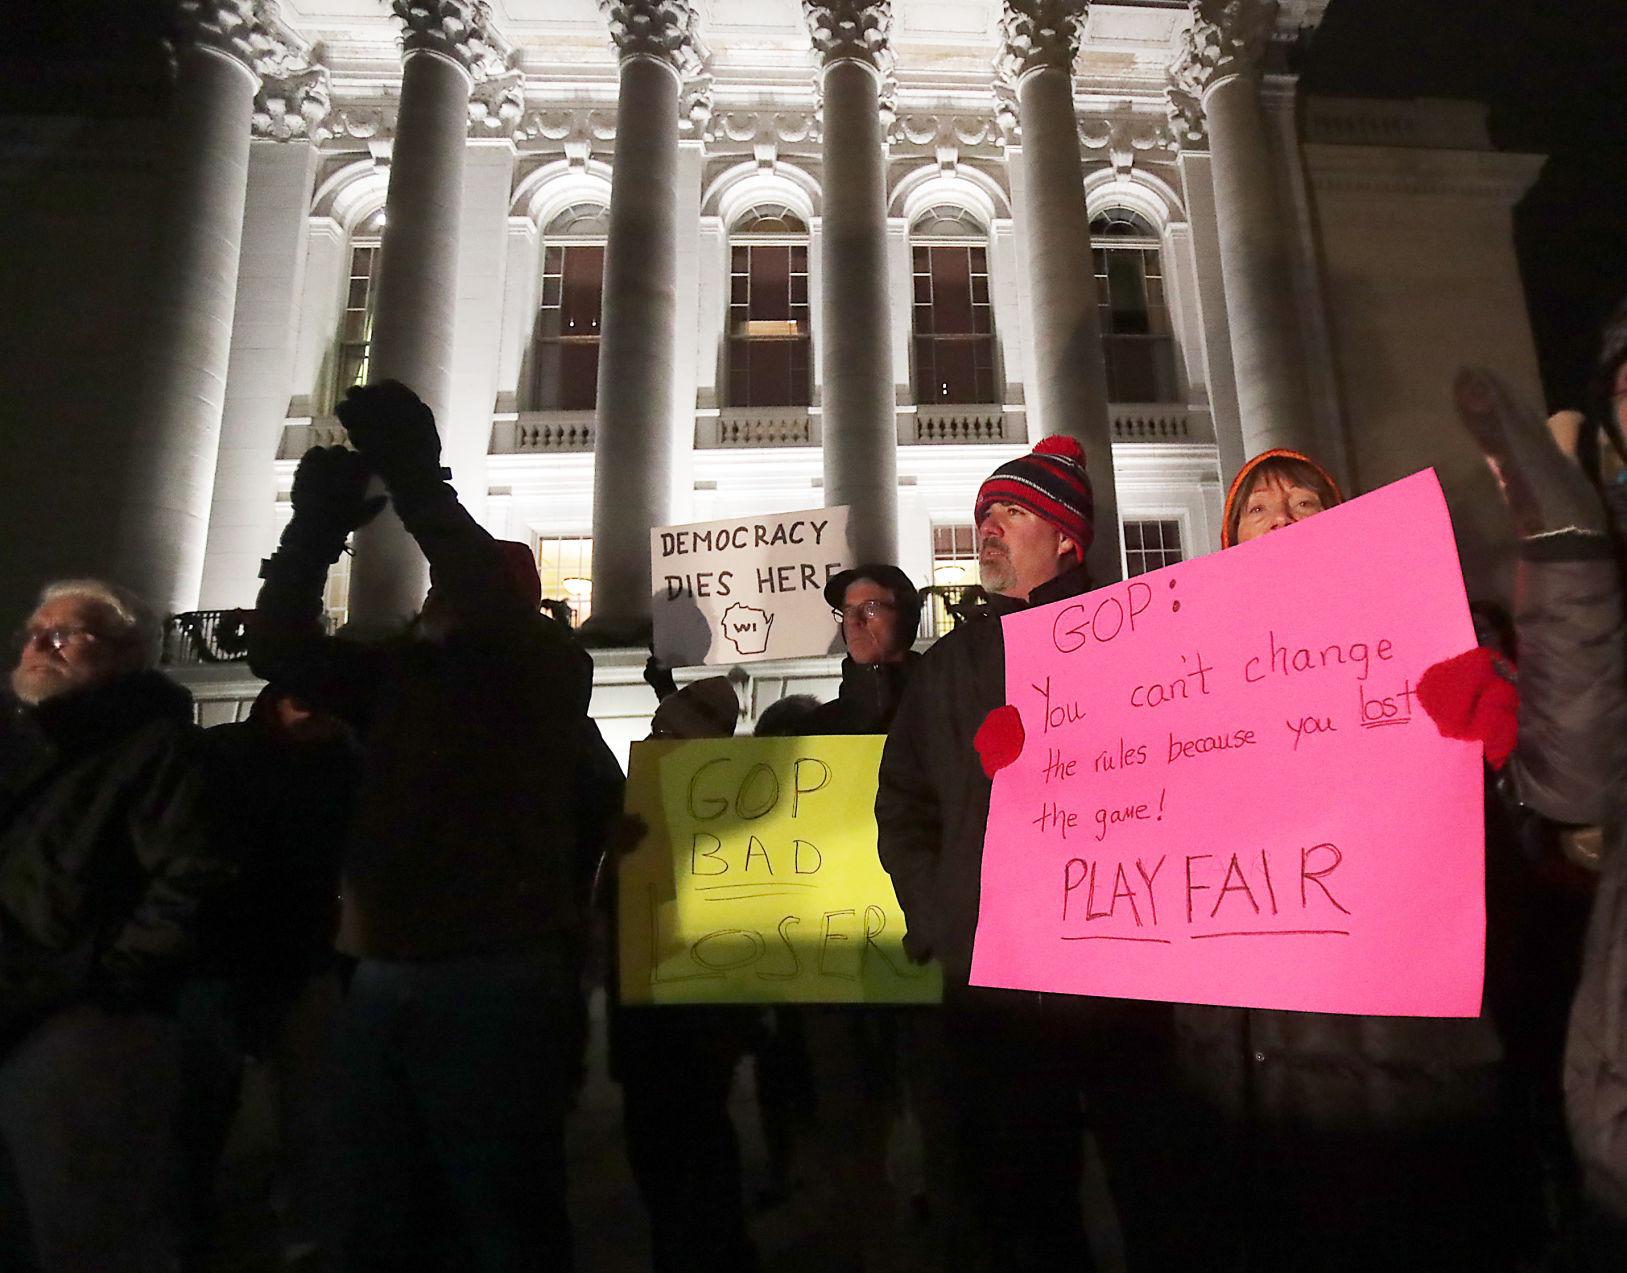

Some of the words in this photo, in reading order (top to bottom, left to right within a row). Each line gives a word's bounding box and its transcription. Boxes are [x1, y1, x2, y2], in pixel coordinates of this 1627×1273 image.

[661, 520, 828, 557] DEMOCRACY
[665, 570, 734, 601] DIES
[733, 622, 757, 633] WI
[1032, 676, 1087, 733] You
[1130, 653, 1214, 707] can't
[1245, 630, 1393, 682] change
[1042, 748, 1077, 784] the
[1095, 737, 1147, 773] rules
[1168, 732, 1257, 764] because
[1286, 716, 1338, 751] you
[1360, 679, 1417, 722] lost
[687, 757, 833, 822] GOP
[1032, 802, 1078, 839] the
[1095, 788, 1166, 841] game!
[691, 833, 822, 876] BAD
[1063, 854, 1167, 927] PLAY
[1186, 842, 1351, 923] FAIR
[650, 882, 929, 986] LOSER
